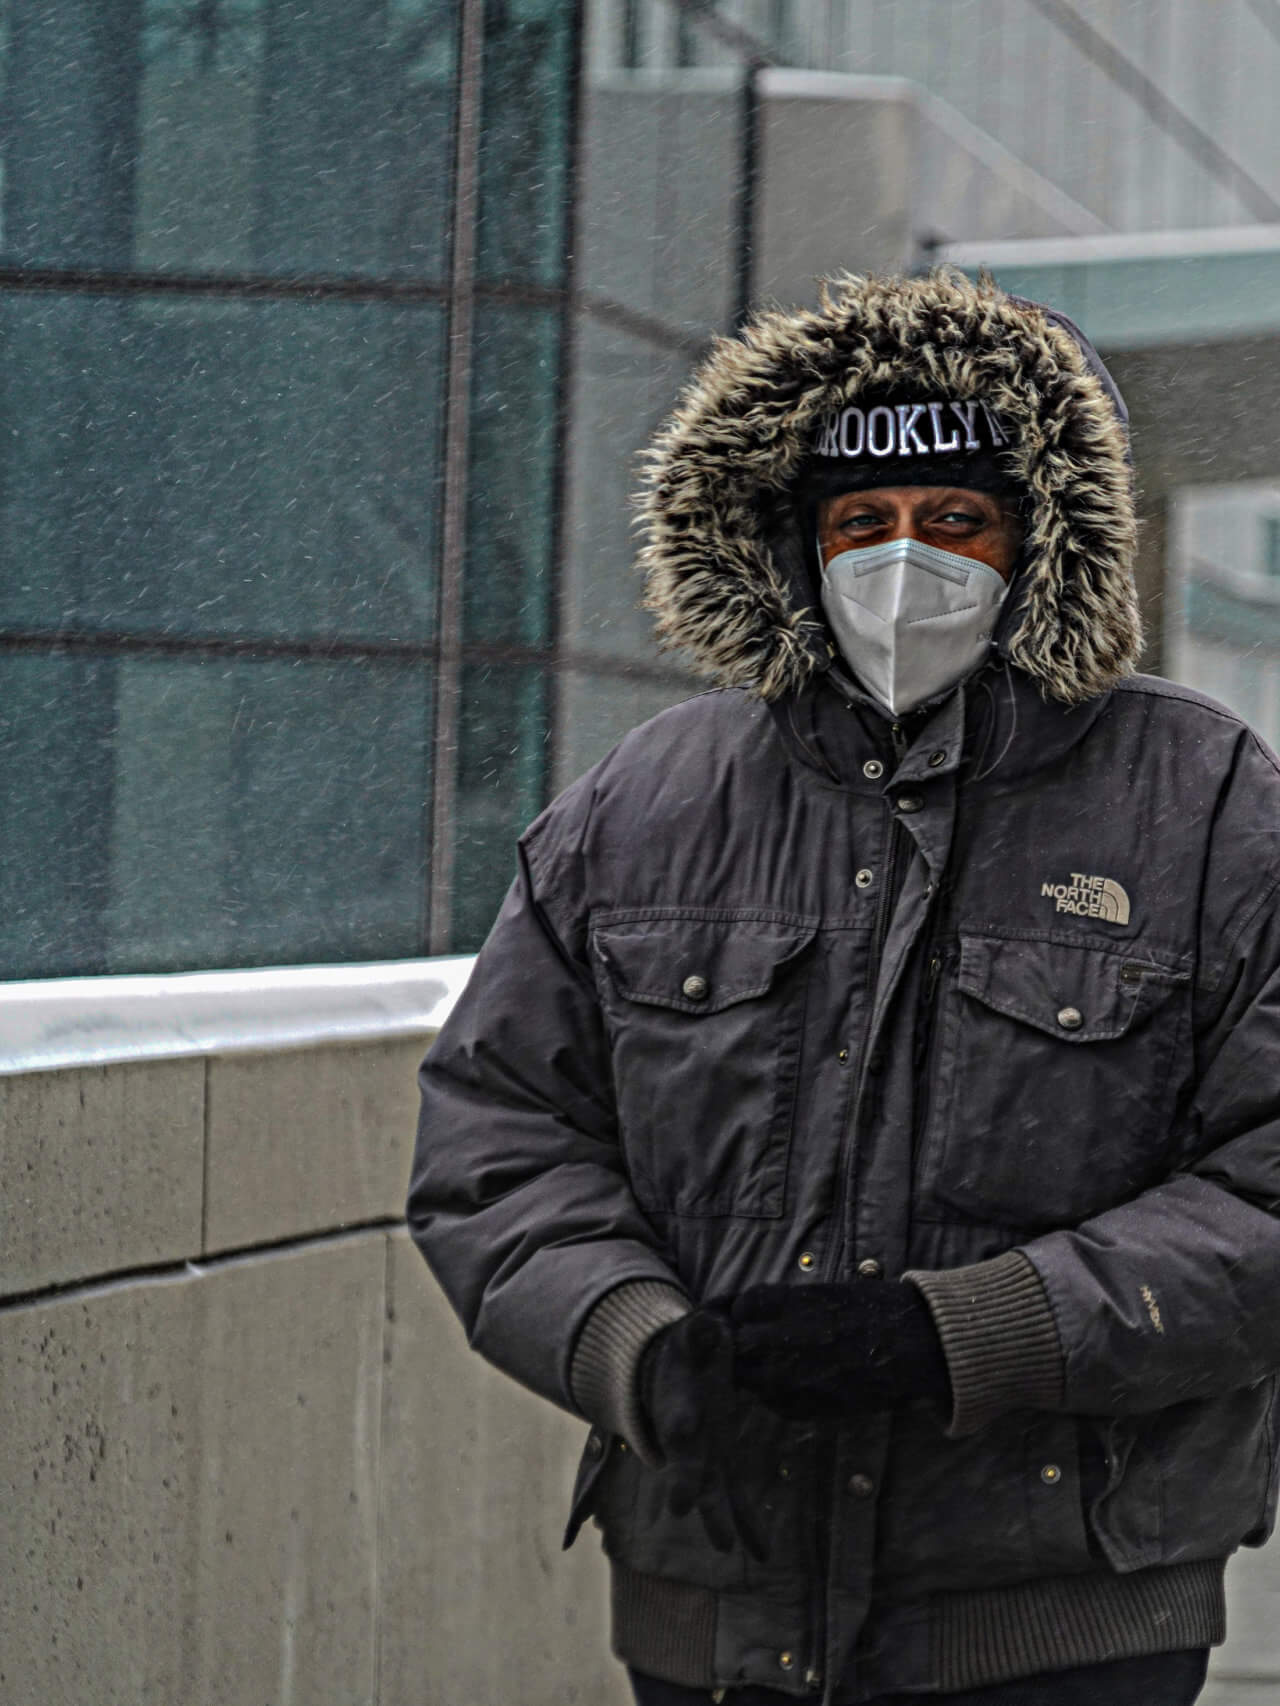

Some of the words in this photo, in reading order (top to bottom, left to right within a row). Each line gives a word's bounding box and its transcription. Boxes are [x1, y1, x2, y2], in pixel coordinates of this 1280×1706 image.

[1070, 872, 1105, 890] THE
[1041, 882, 1103, 905] NORTH
[1055, 899, 1101, 918] FACE
